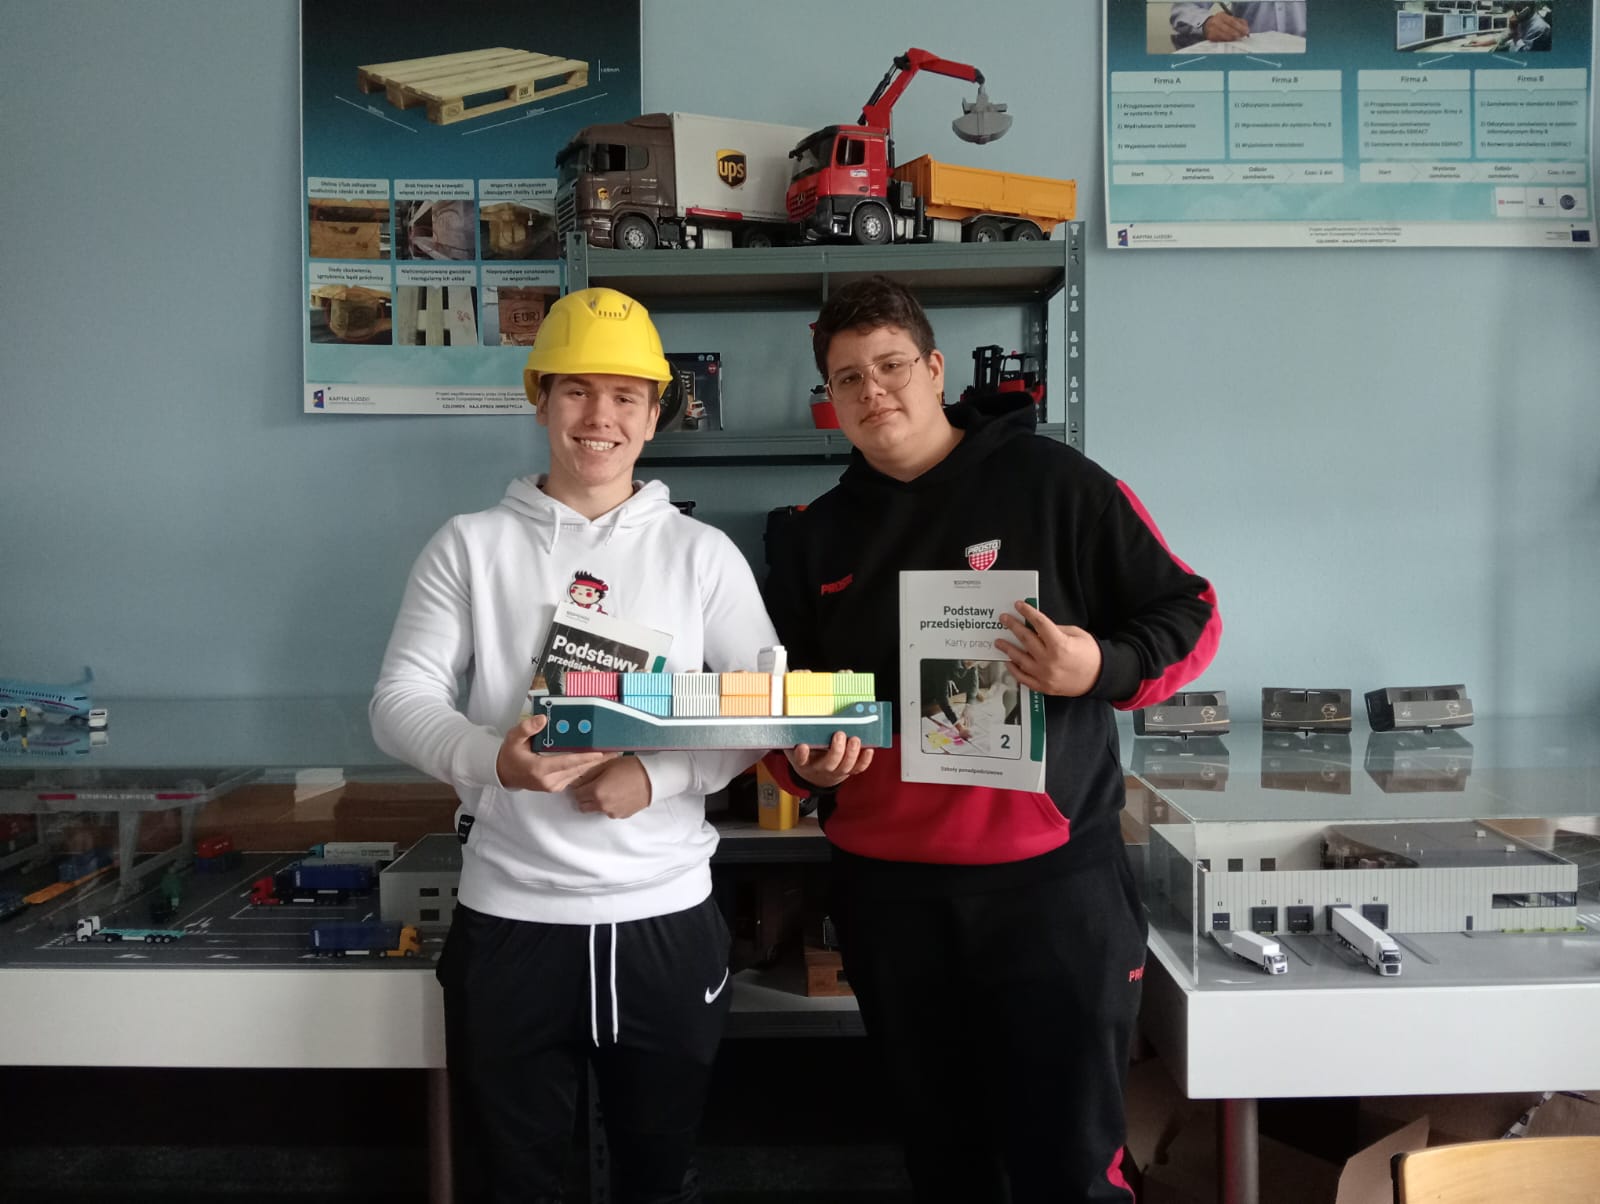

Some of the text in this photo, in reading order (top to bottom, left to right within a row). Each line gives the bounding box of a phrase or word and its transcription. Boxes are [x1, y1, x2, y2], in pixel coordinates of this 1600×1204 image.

[719, 160, 744, 182] ups
[966, 540, 1000, 557] PROSTO
[943, 605, 995, 618] Podstawy
[945, 639, 993, 649] Karty pracy
[552, 634, 639, 672] Podstawy
[1000, 734, 1011, 749] 2
